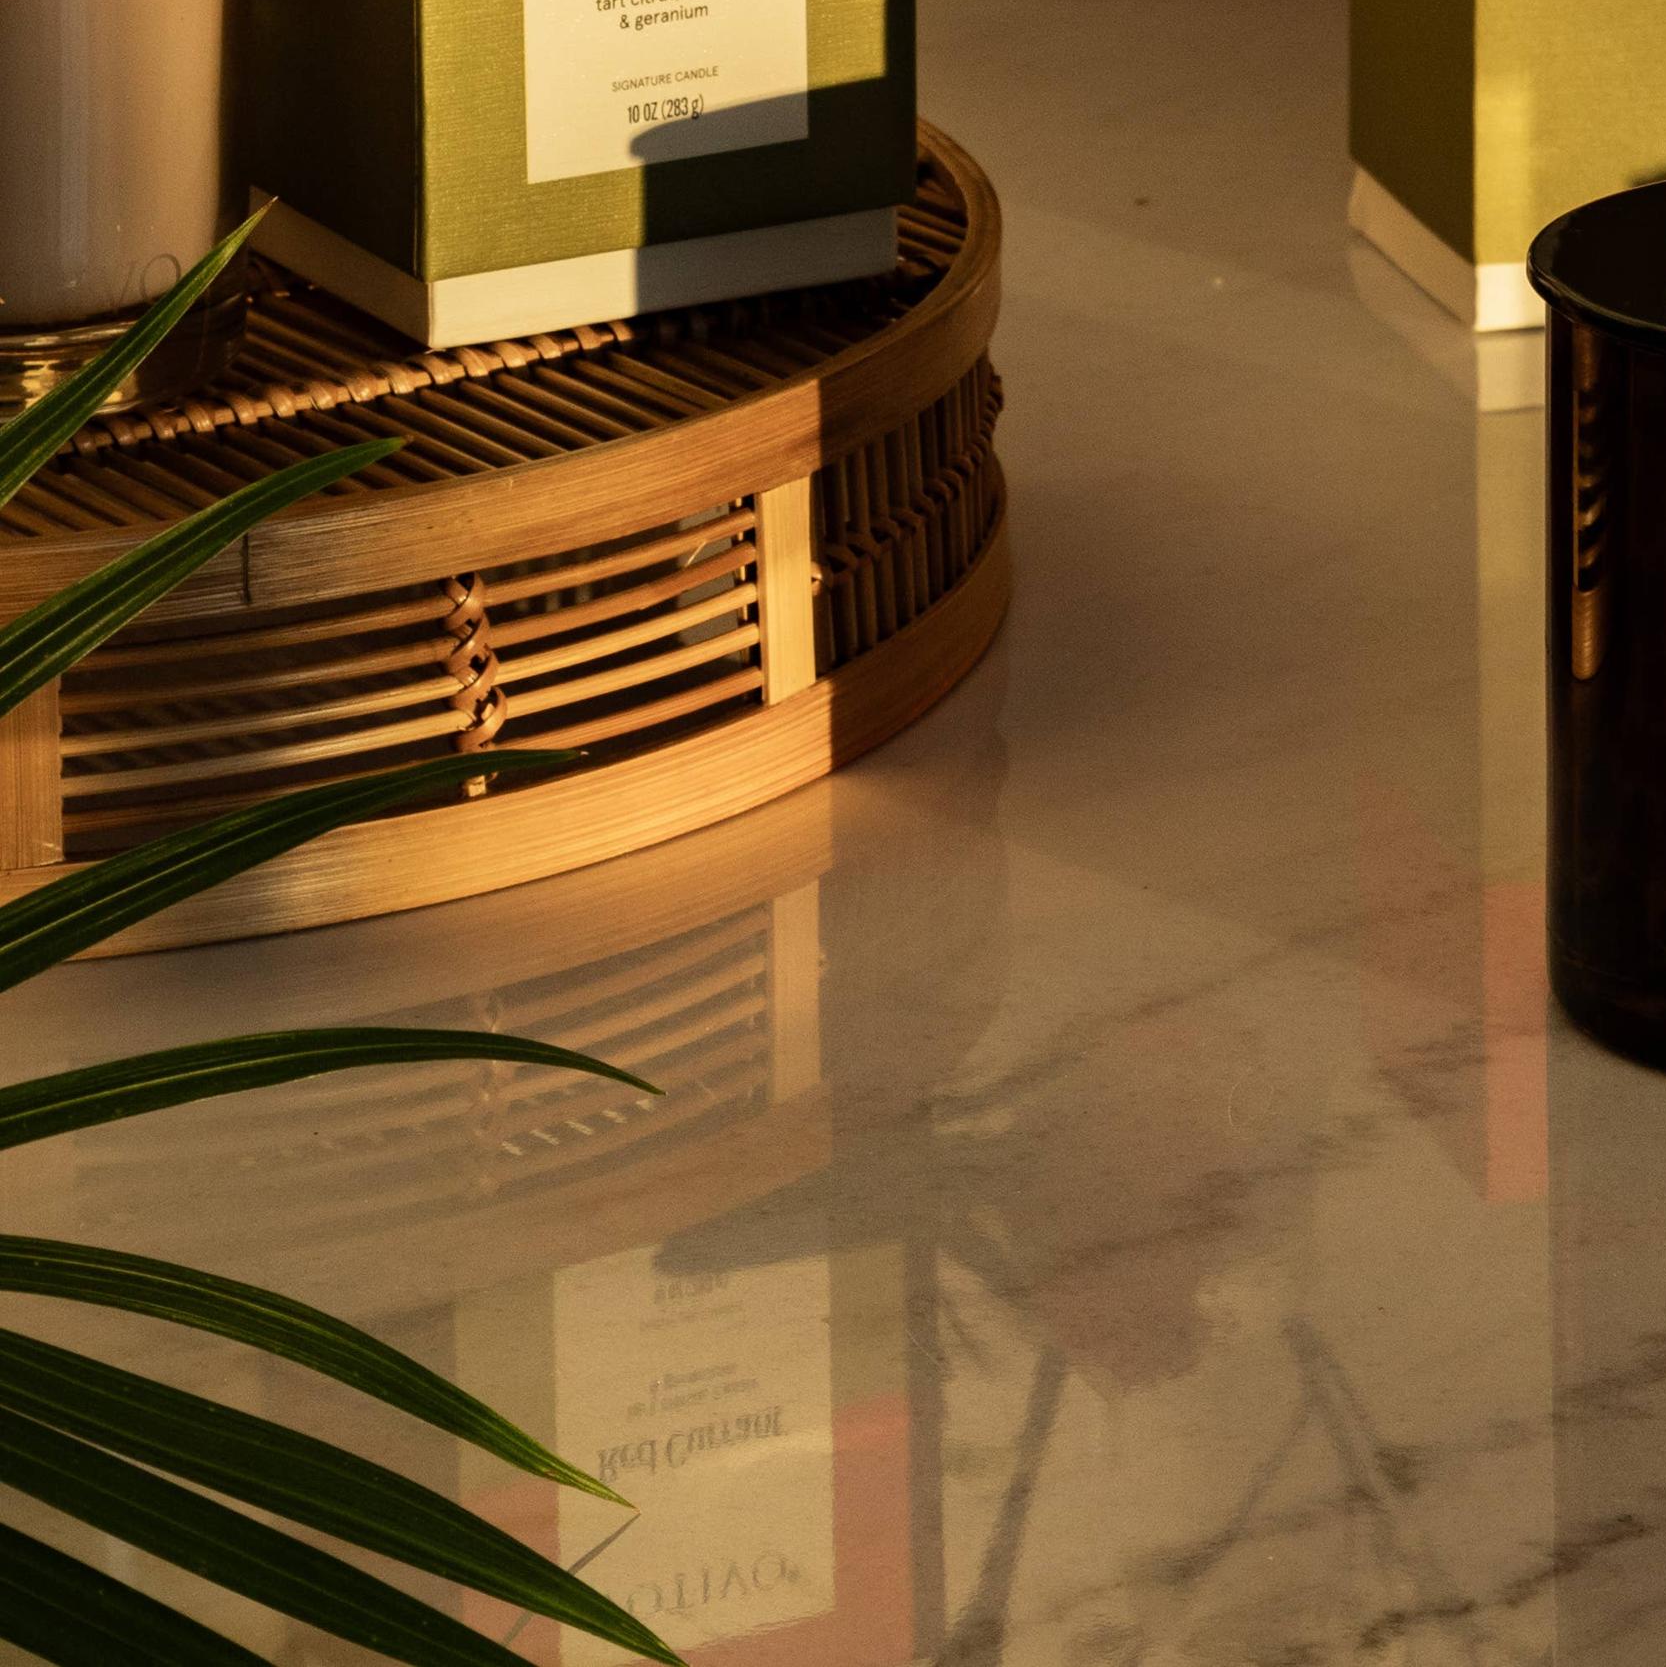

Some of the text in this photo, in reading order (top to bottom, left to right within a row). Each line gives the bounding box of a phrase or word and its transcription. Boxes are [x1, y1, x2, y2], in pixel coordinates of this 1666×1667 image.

[619, 3, 709, 31] & geranium
[611, 65, 719, 93] SIGNATURE CANDLE
[626, 94, 704, 125] 10 OZ (283 g)
